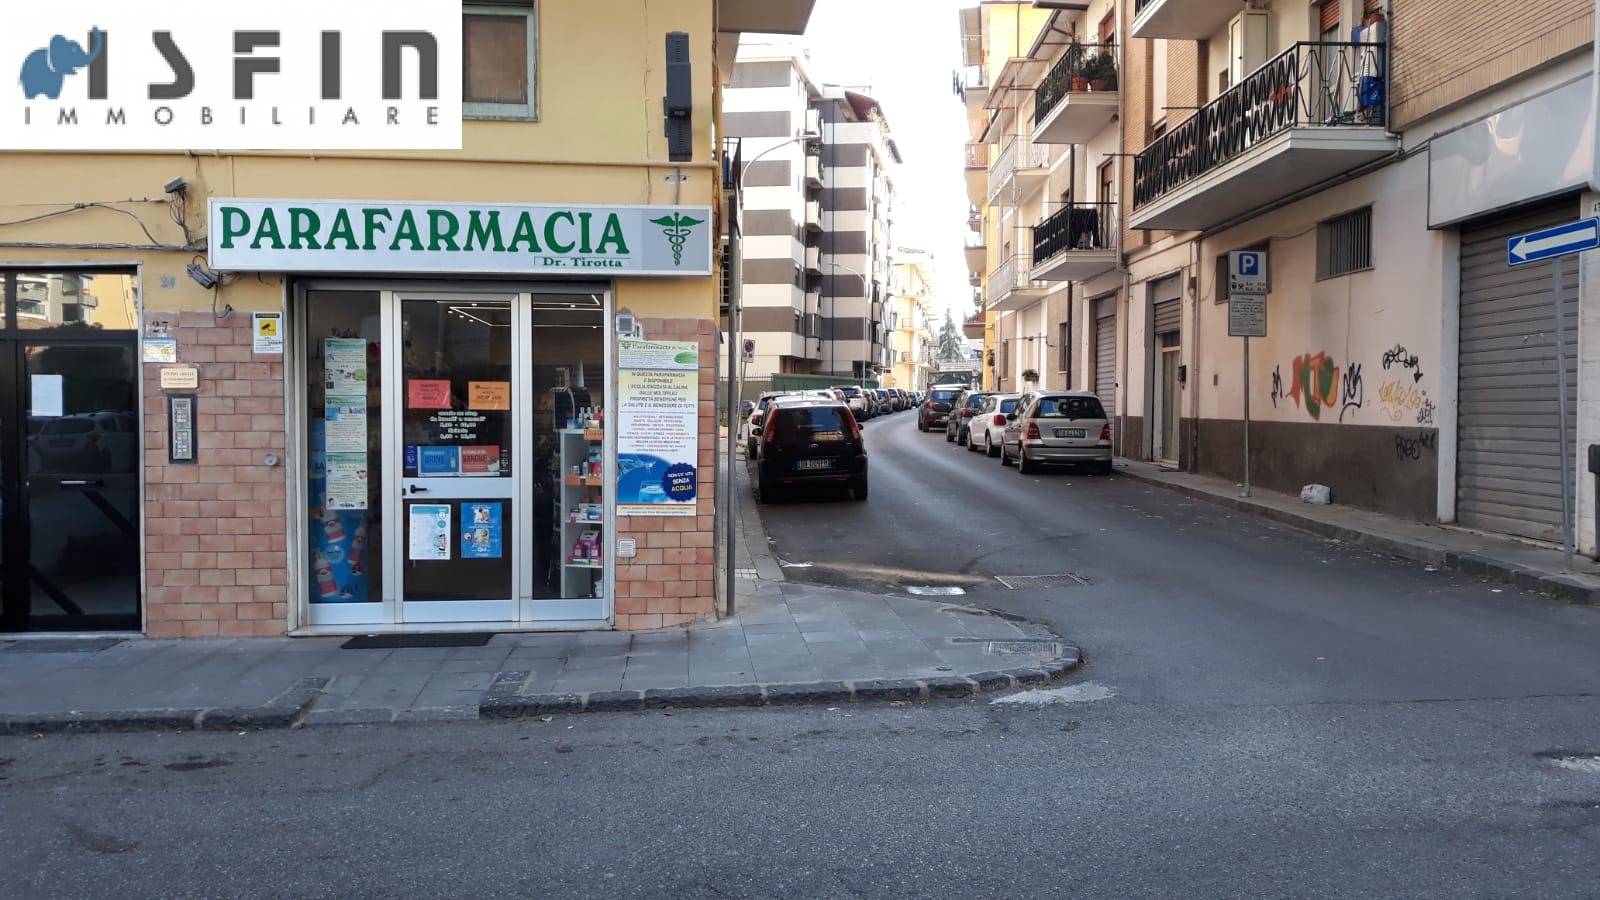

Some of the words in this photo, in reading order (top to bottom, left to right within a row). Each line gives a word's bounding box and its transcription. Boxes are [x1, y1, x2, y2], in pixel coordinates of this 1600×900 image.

[220, 207, 630, 254] PARAFARMACIA
[543, 257, 566, 267] Dr.
[573, 257, 623, 268] Tirotta
[1242, 255, 1255, 274] P
[152, 320, 169, 333] 27
